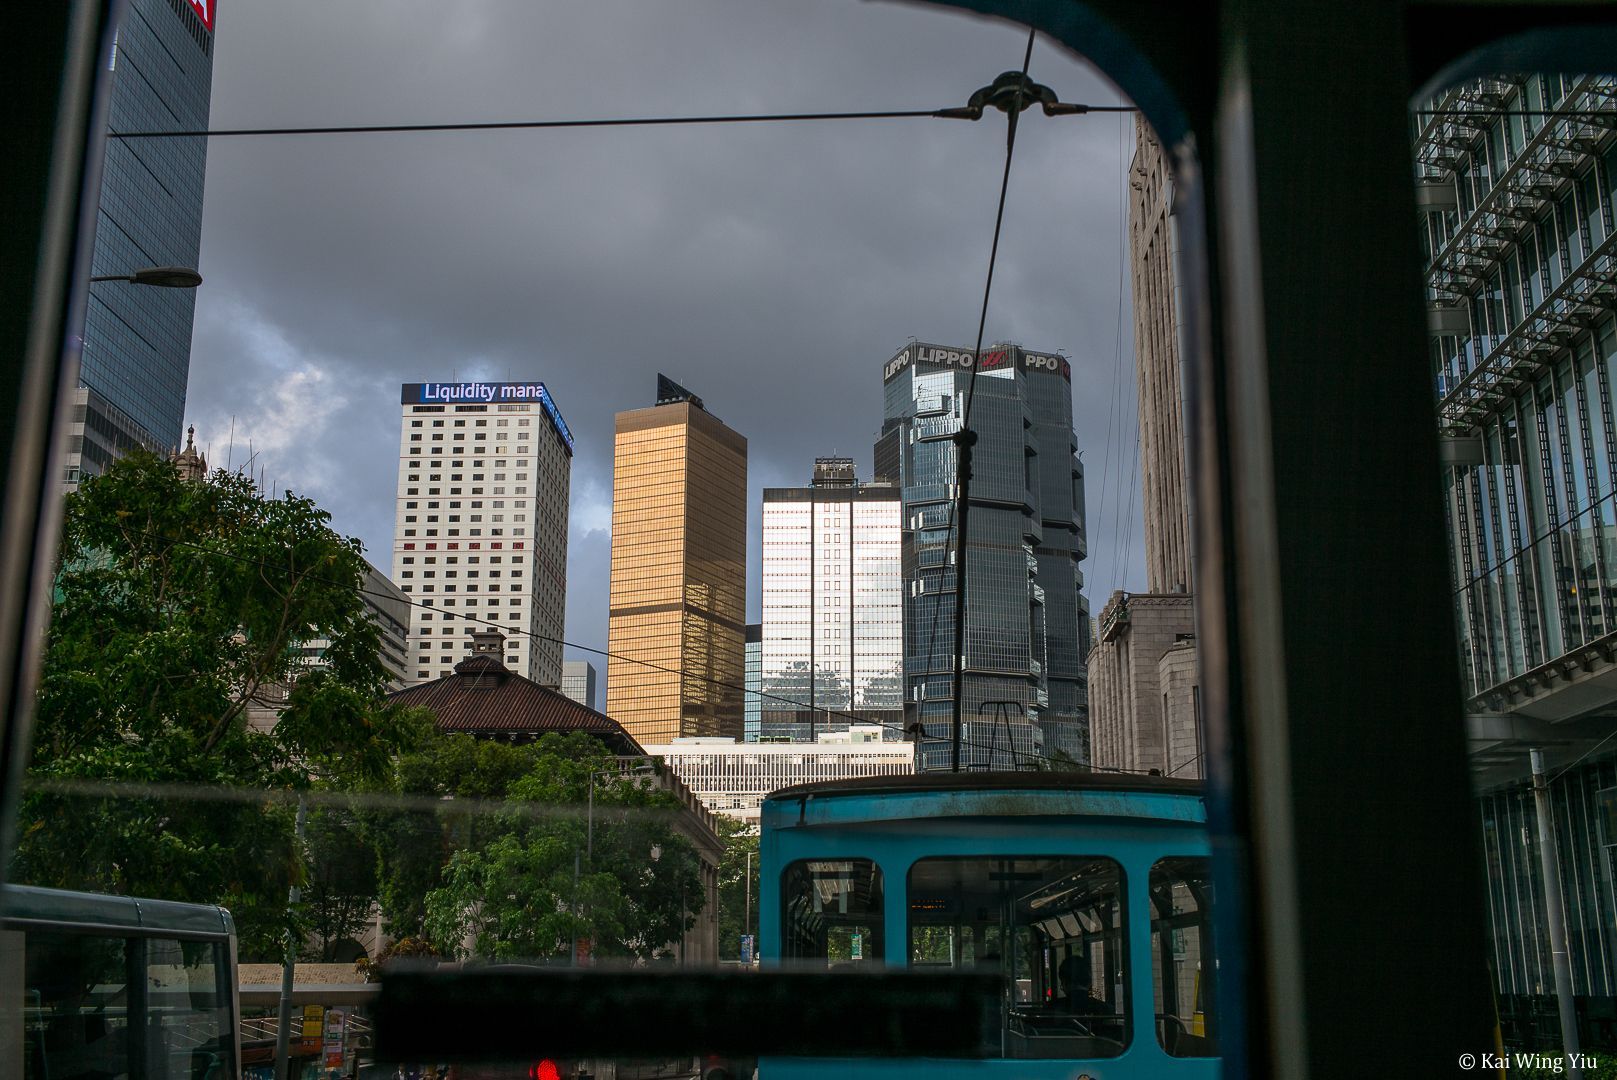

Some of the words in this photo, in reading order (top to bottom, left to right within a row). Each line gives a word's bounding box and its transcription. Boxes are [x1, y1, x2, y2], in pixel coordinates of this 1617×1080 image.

[884, 350, 910, 379] LIPPO
[917, 347, 974, 368] LIPPO
[425, 382, 496, 402] Liquidity
[500, 385, 543, 398] mana
